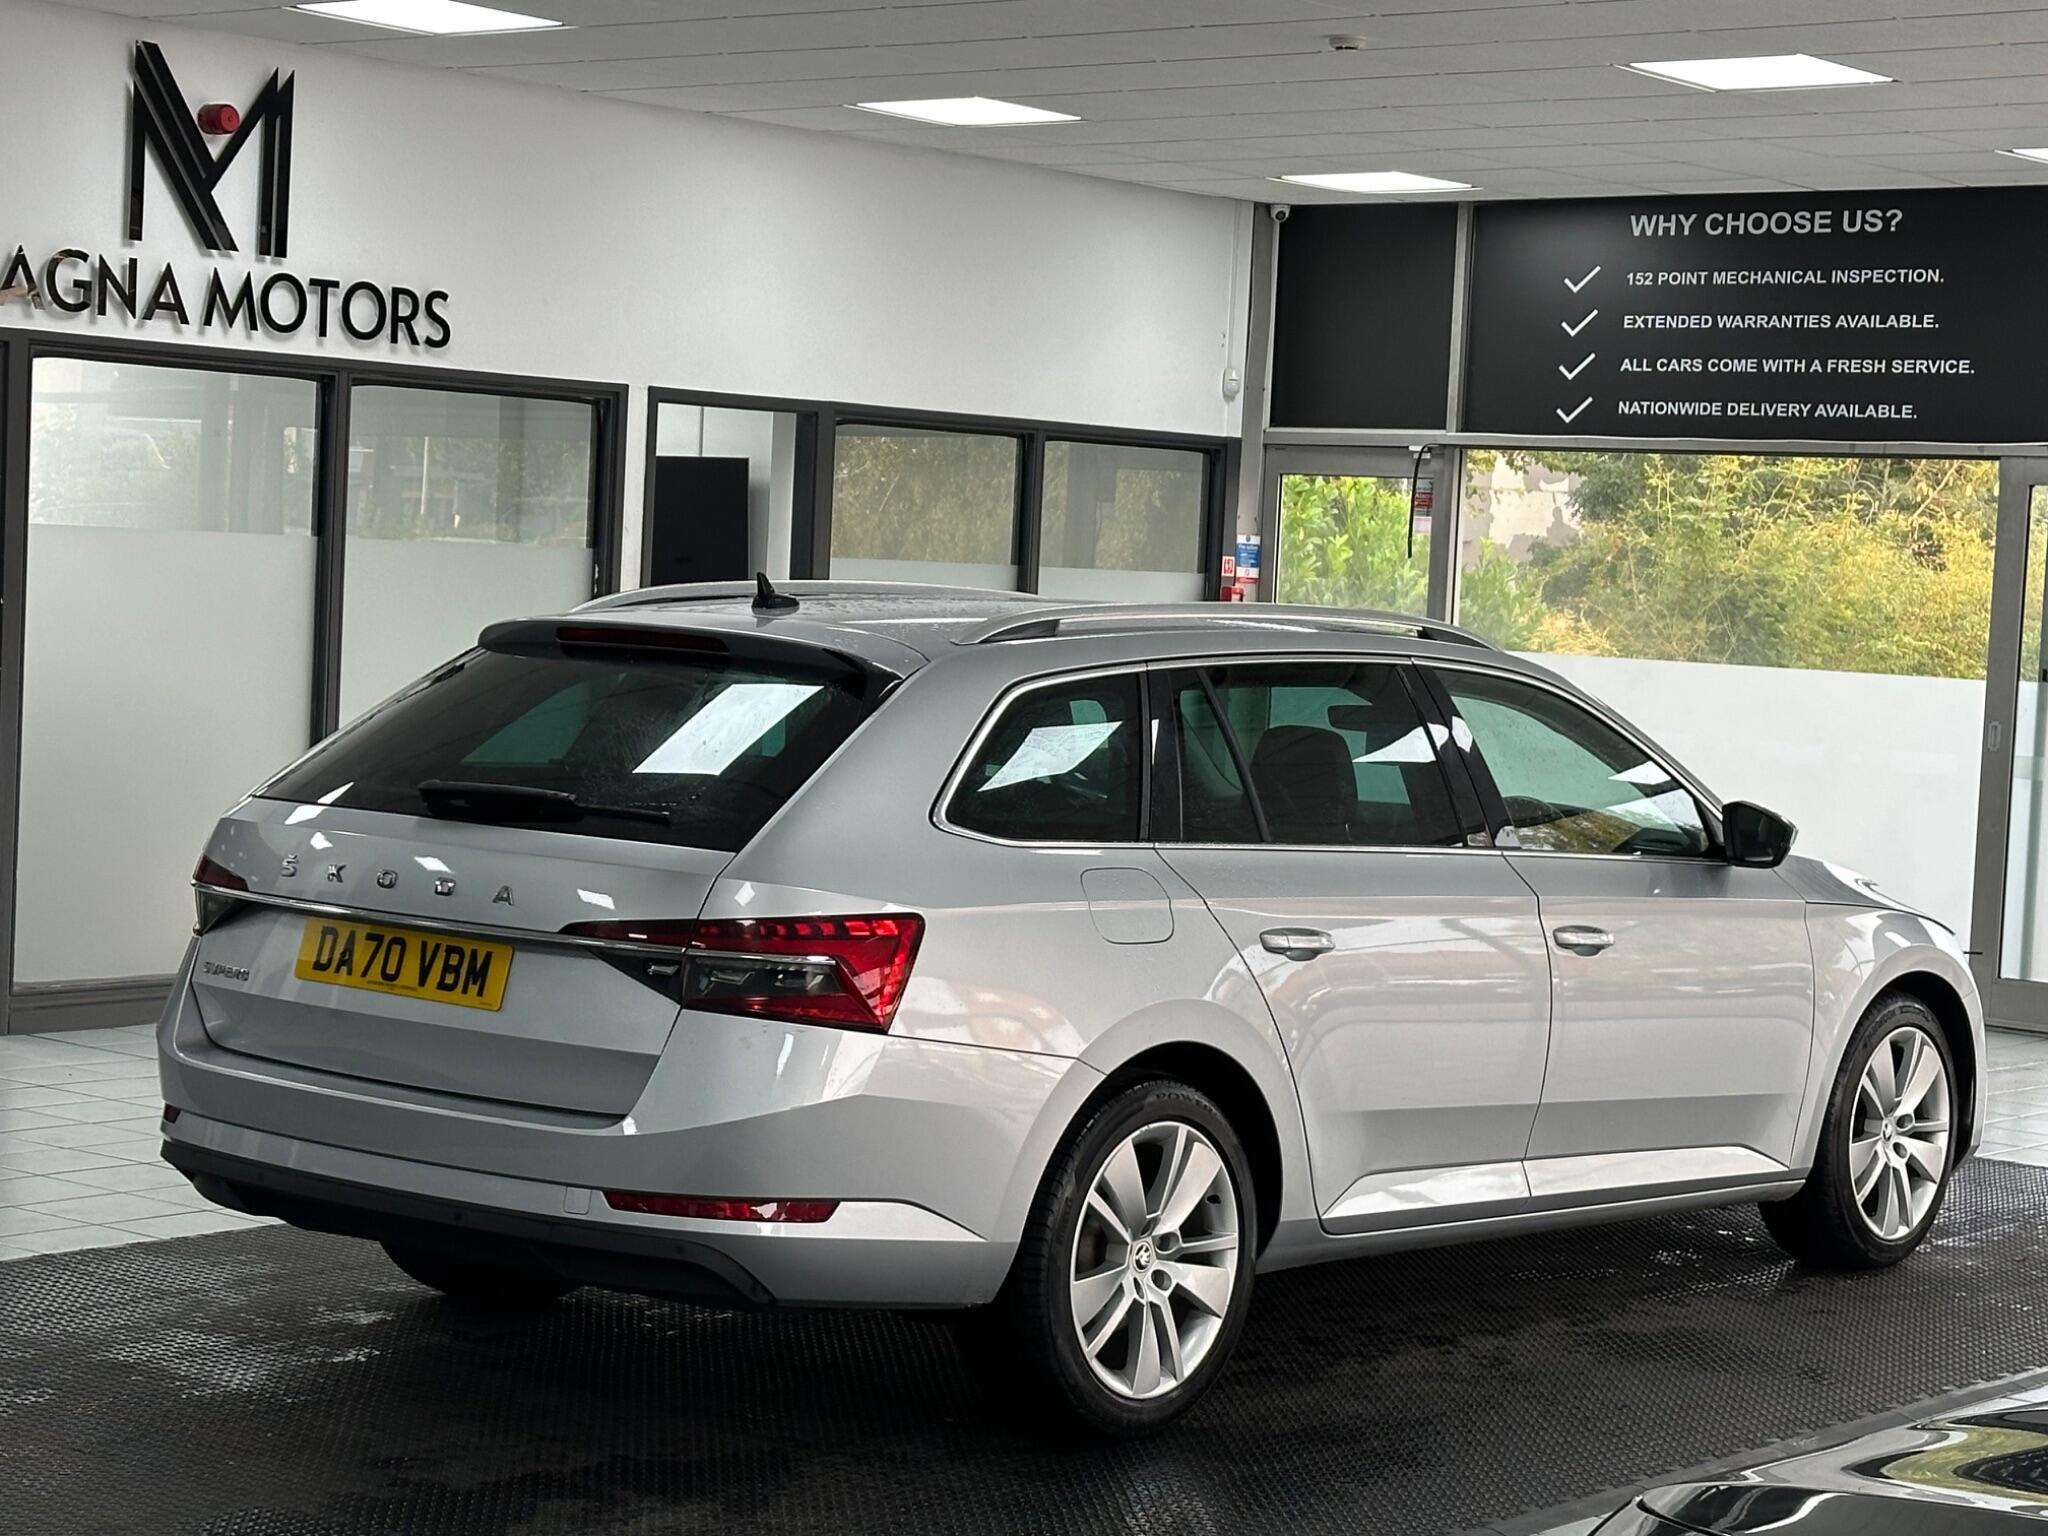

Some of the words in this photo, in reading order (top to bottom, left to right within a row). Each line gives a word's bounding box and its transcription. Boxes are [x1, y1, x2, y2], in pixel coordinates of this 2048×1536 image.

[1630, 213, 1697, 236] WHY
[1704, 210, 1833, 236] CHOOSE
[1842, 209, 1903, 233] US?
[1626, 271, 1654, 286] 152
[1657, 271, 1709, 286] POINT
[1712, 270, 1827, 285] MECHANICAL
[1831, 268, 1944, 284] INSPECTION.
[203, 267, 451, 349] MOTORS
[1623, 314, 1713, 329] EXTENDED
[1716, 314, 1832, 329] WARRANTIES
[1834, 314, 1939, 329] AVAILABLE.
[1619, 358, 1653, 372] ALL
[1656, 358, 1703, 373] CARS
[1707, 358, 1758, 373] COME
[1762, 358, 1806, 373] WITH
[1809, 359, 1823, 373] A
[1826, 359, 1886, 374] FRESH
[1891, 359, 1975, 374] SERVICE.
[1618, 400, 1723, 416] NATIONWIDE
[1726, 402, 1812, 417] DELIVERY
[1815, 403, 1918, 419] AVAILABLE.
[312, 925, 406, 982] DA70
[417, 940, 494, 998] VBM
